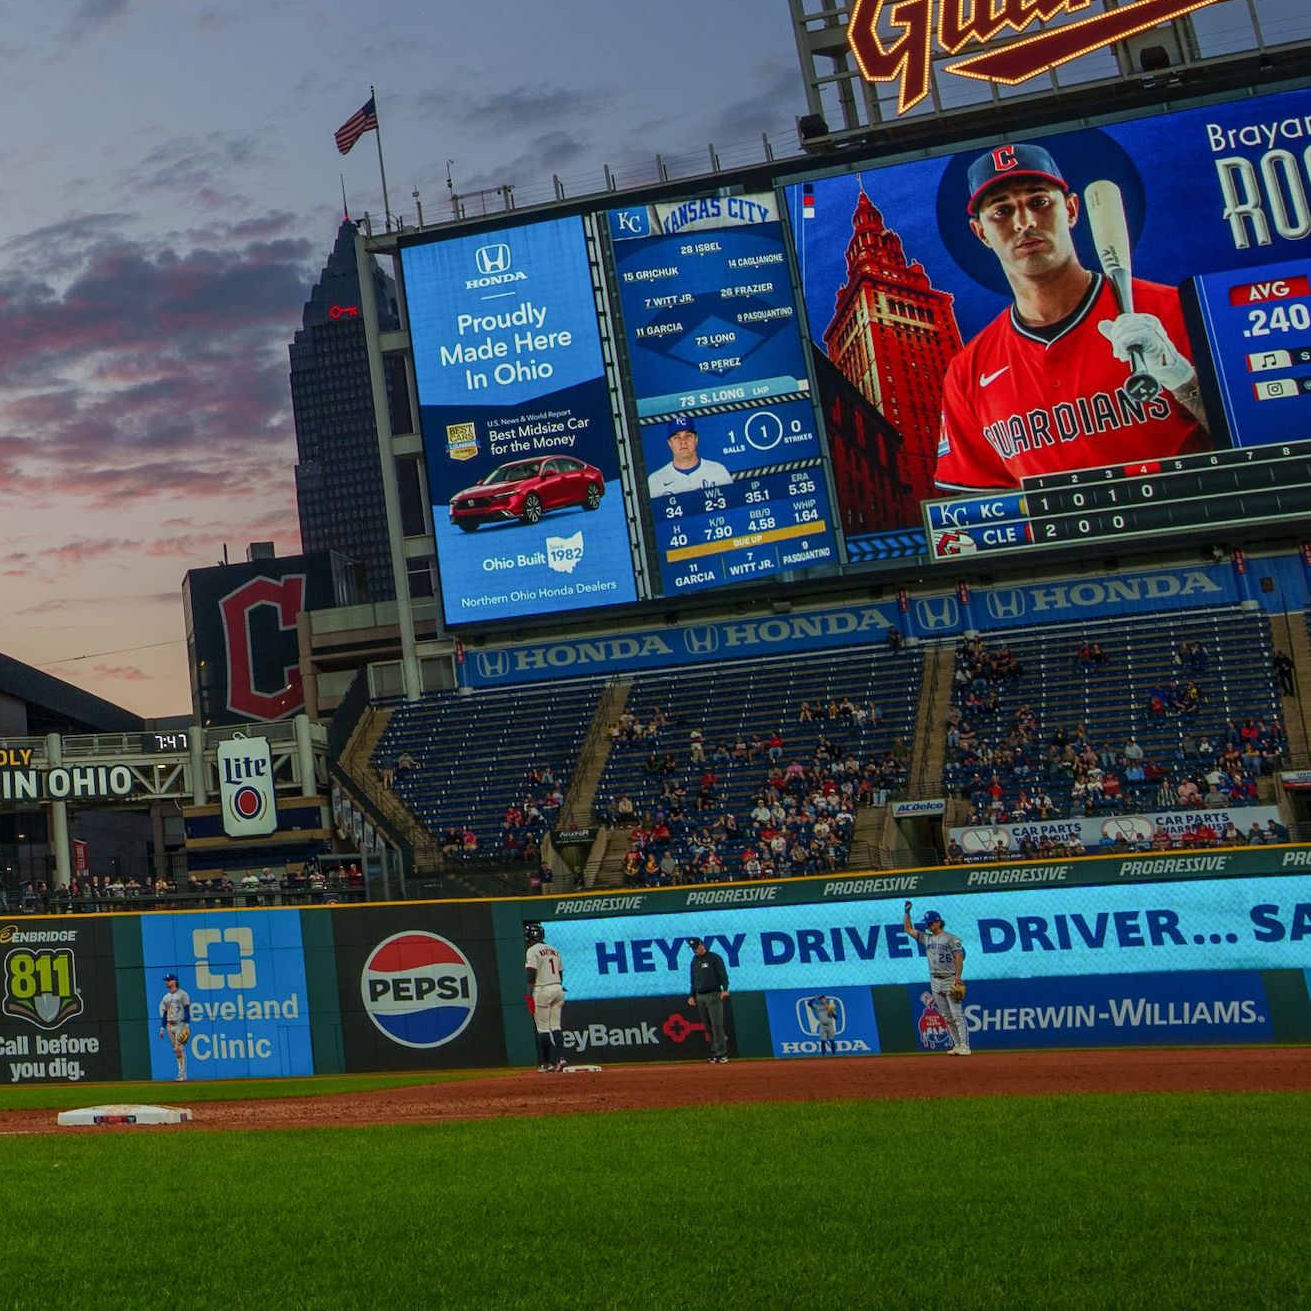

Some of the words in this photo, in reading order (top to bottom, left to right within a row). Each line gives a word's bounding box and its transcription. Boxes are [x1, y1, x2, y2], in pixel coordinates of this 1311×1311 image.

[991, 145, 1017, 171] C
[617, 211, 642, 233] KC
[663, 197, 721, 234] KANSAS
[728, 198, 769, 223] CITY
[680, 245, 693, 255] 28
[695, 242, 721, 253] ISBEL
[728, 259, 737, 268] 14
[738, 253, 783, 267] CAGLIANONE
[465, 271, 528, 289] HONDA
[623, 271, 634, 282] 15
[636, 266, 679, 281] GRICHUK
[1249, 281, 1290, 301] AVG
[457, 301, 547, 336] Proudly
[1243, 303, 1311, 338] .240
[440, 337, 508, 367] Made
[514, 330, 572, 354] Here
[466, 369, 488, 390] In
[494, 359, 554, 386] Ohio
[699, 362, 710, 371] 13
[711, 357, 741, 369] PEREZ
[450, 424, 474, 434] BEST
[450, 432, 475, 443] CARS
[489, 429, 517, 443] Best
[518, 421, 565, 438] Midsize
[567, 417, 590, 430] Car
[490, 444, 509, 456] for
[510, 440, 531, 452] the
[533, 434, 576, 449] Money
[723, 444, 746, 455] BALLS
[784, 433, 812, 444] STRIKES
[483, 556, 515, 571] Ohio
[517, 551, 547, 568] Built
[550, 547, 582, 562] 1982
[675, 570, 715, 587] GARCIA
[1031, 571, 1223, 611] HONDA
[461, 595, 508, 608] Northern
[510, 591, 537, 602] Ohio
[539, 585, 574, 598] Honda
[576, 580, 617, 594] Dealers
[723, 608, 894, 646] HONDA
[218, 574, 307, 722] C
[515, 634, 673, 671] HONDA
[155, 734, 187, 750] 7:47
[3, 770, 37, 799] IN
[48, 765, 131, 798] OHIO
[222, 756, 267, 785] Lite
[1012, 826, 1038, 837] CAR
[1040, 823, 1082, 834] PARTS
[1156, 815, 1183, 826] CAR
[1185, 812, 1229, 824] PARTS
[555, 896, 643, 914] PROGRESSIVE
[686, 887, 777, 905] PROGRESSIVE
[824, 876, 918, 896] PROGRESSIVE
[968, 865, 1069, 885] PROGRESSIVE
[1120, 855, 1227, 876] PROGRESSIVE
[12, 930, 77, 943] ENBRIDGE
[977, 909, 1238, 955] DRIVER...
[549, 958, 555, 974] 1
[939, 953, 952, 963] 26
[10, 953, 71, 998] 811
[368, 975, 470, 1002] PEPSI
[159, 993, 299, 1021] eveland
[965, 998, 1256, 1032] SHERWIN-WILLIAMS
[36, 1033, 100, 1055] before
[191, 1031, 272, 1061] Clinic
[563, 1021, 660, 1052] eyBank
[10, 1062, 46, 1082] you
[48, 1057, 85, 1081] dig.
